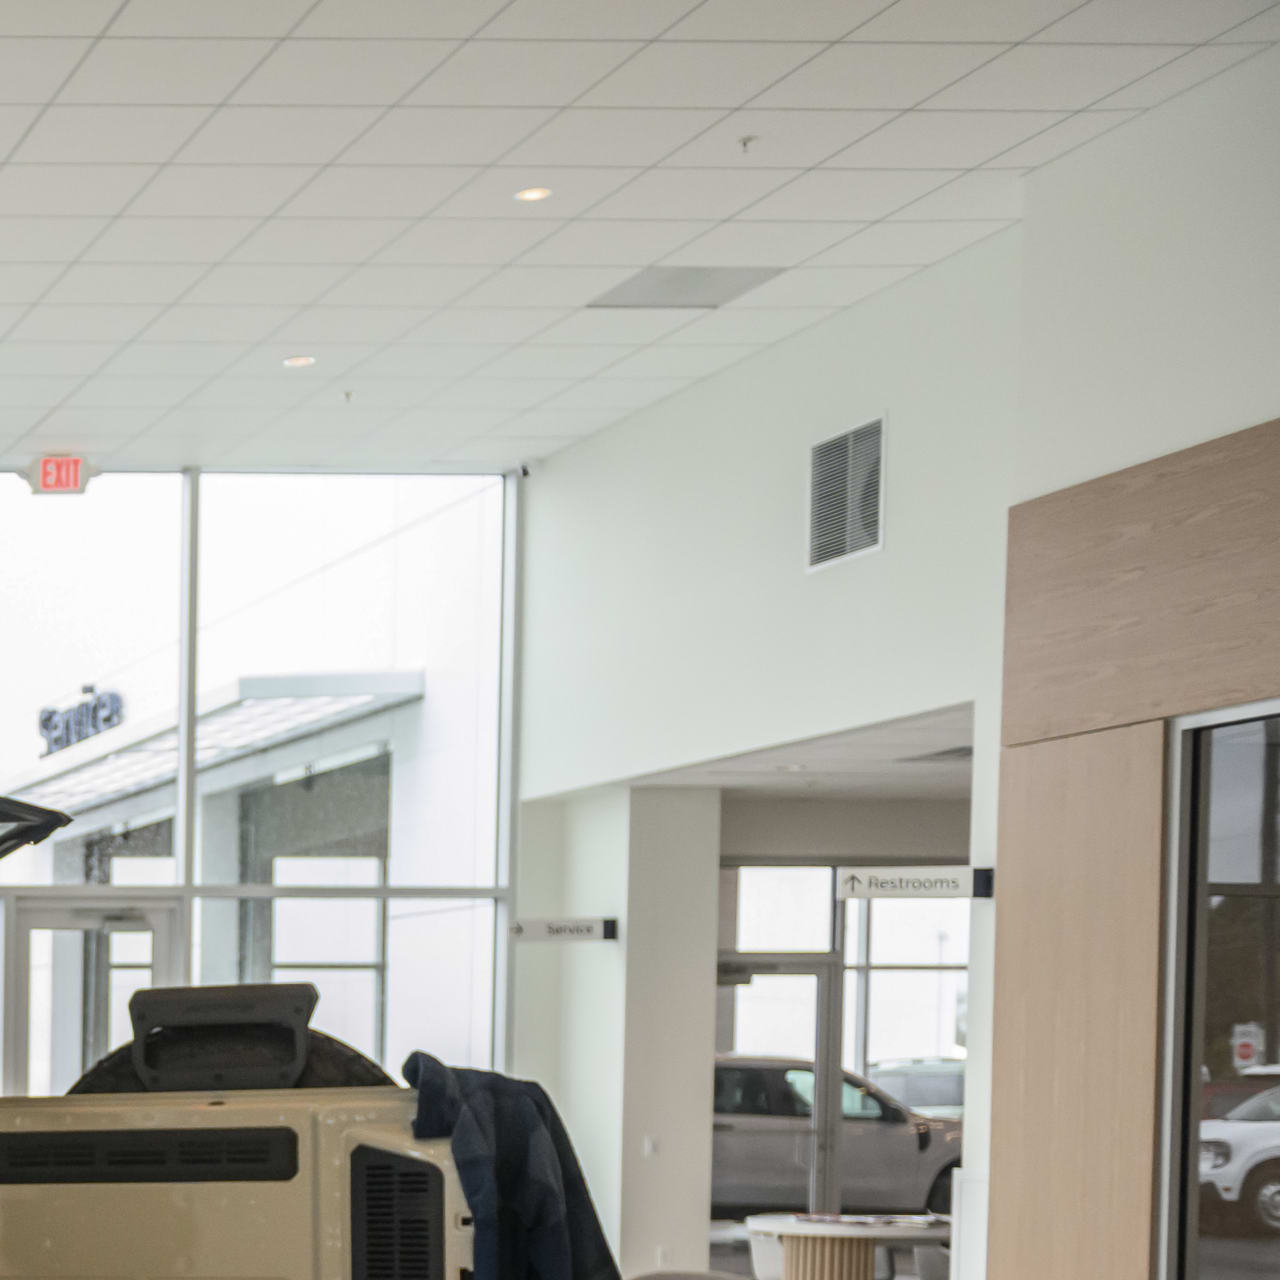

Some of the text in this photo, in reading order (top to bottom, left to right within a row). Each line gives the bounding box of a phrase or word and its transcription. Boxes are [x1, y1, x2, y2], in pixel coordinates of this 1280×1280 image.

[41, 457, 82, 490] EXIT
[868, 875, 959, 890] Restrooms
[547, 923, 593, 935] Service
